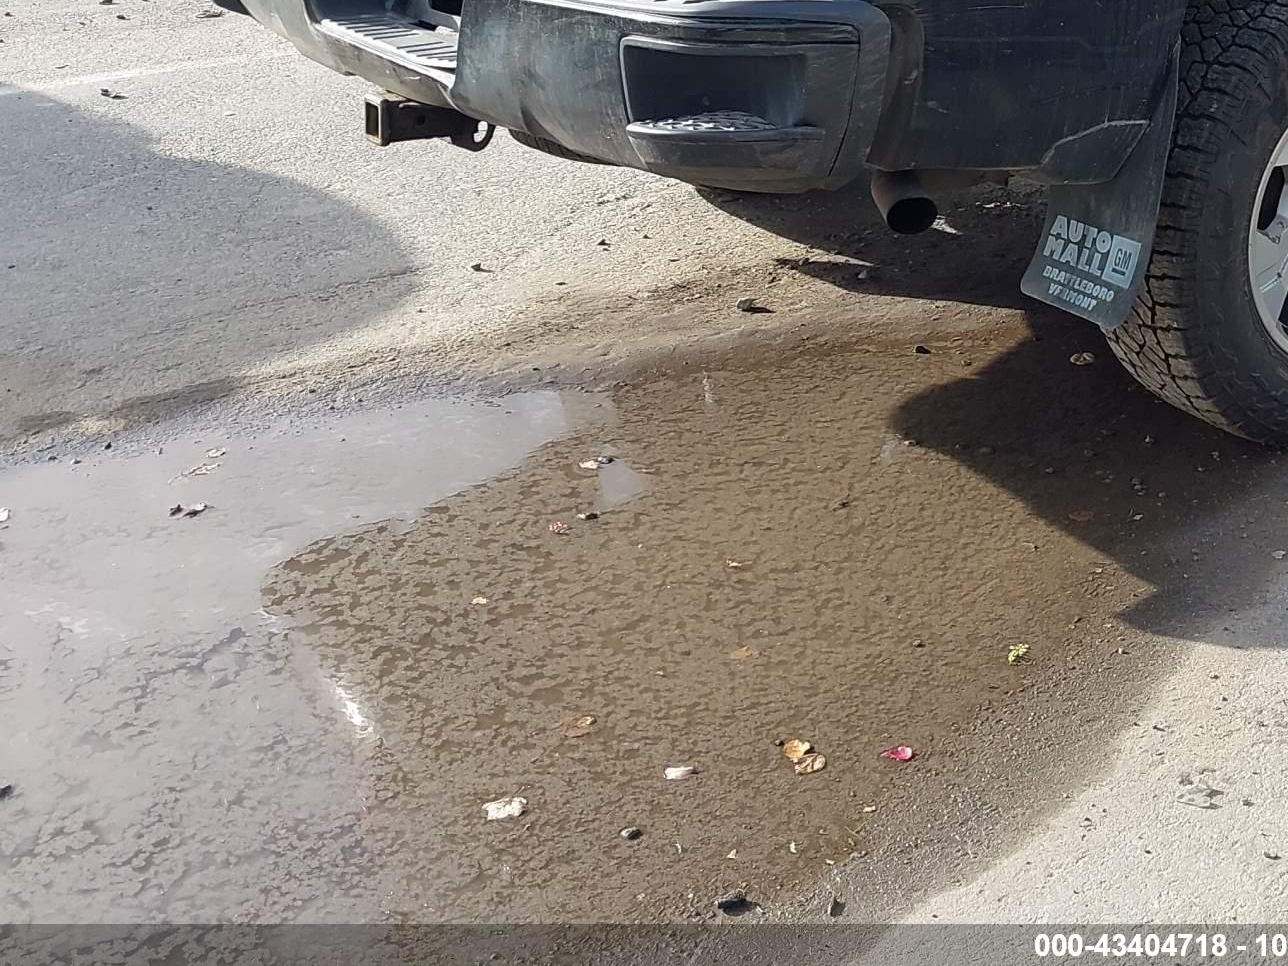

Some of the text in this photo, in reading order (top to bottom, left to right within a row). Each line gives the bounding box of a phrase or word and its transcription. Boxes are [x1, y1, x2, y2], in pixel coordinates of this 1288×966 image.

[1050, 215, 1112, 253] AUTO
[1043, 235, 1103, 276] MALL
[1043, 265, 1115, 302] BRATTLEBORO
[1048, 282, 1098, 312] VERMONT
